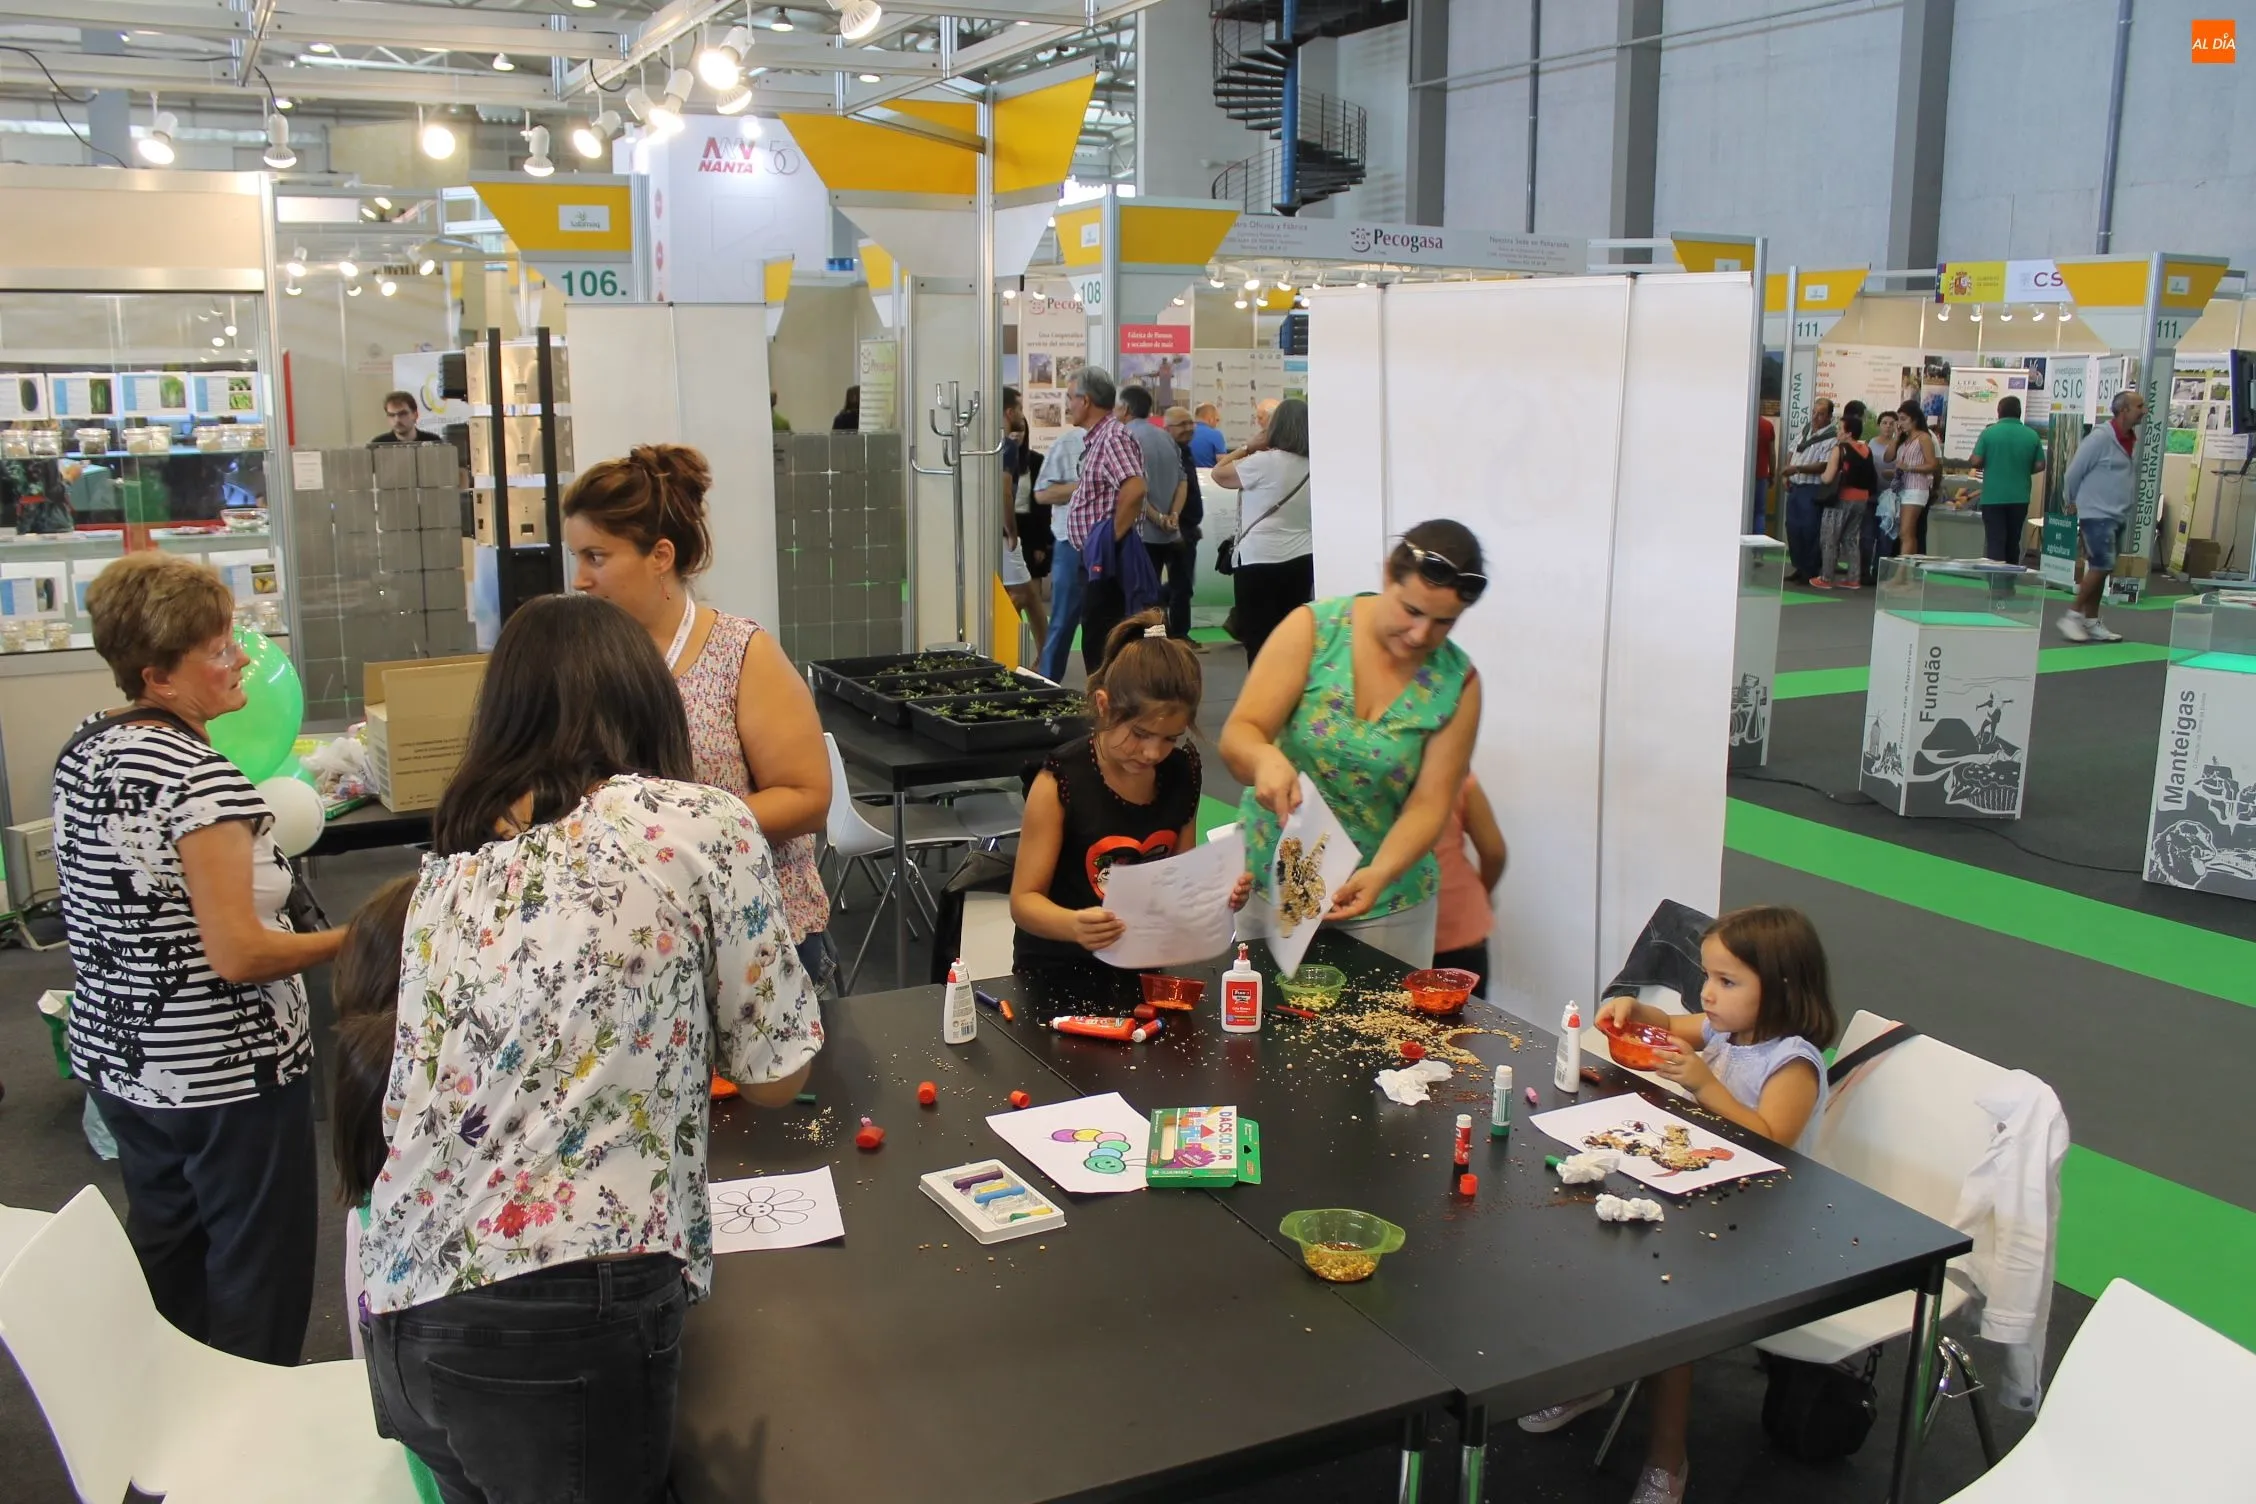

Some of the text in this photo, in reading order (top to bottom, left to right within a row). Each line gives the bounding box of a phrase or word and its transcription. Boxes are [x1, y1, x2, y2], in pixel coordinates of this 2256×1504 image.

[698, 160, 753, 174] NANTA
[1373, 228, 1444, 253] Pecogasa
[561, 270, 628, 297] 106.
[2033, 271, 2064, 288] CS
[1047, 297, 1083, 314] Pecog
[1796, 321, 1824, 338] 111.
[2157, 319, 2182, 339] 111.
[2053, 379, 2083, 399] CSIC
[2143, 420, 2162, 527] CSIC-IRNASA
[2132, 478, 2149, 554] OBIERNO
[2141, 451, 2151, 474] DE
[1919, 646, 1942, 722] Fundão
[2163, 690, 2196, 804] Manteigas
[1218, 1111, 1233, 1161] DACSCOLOR
